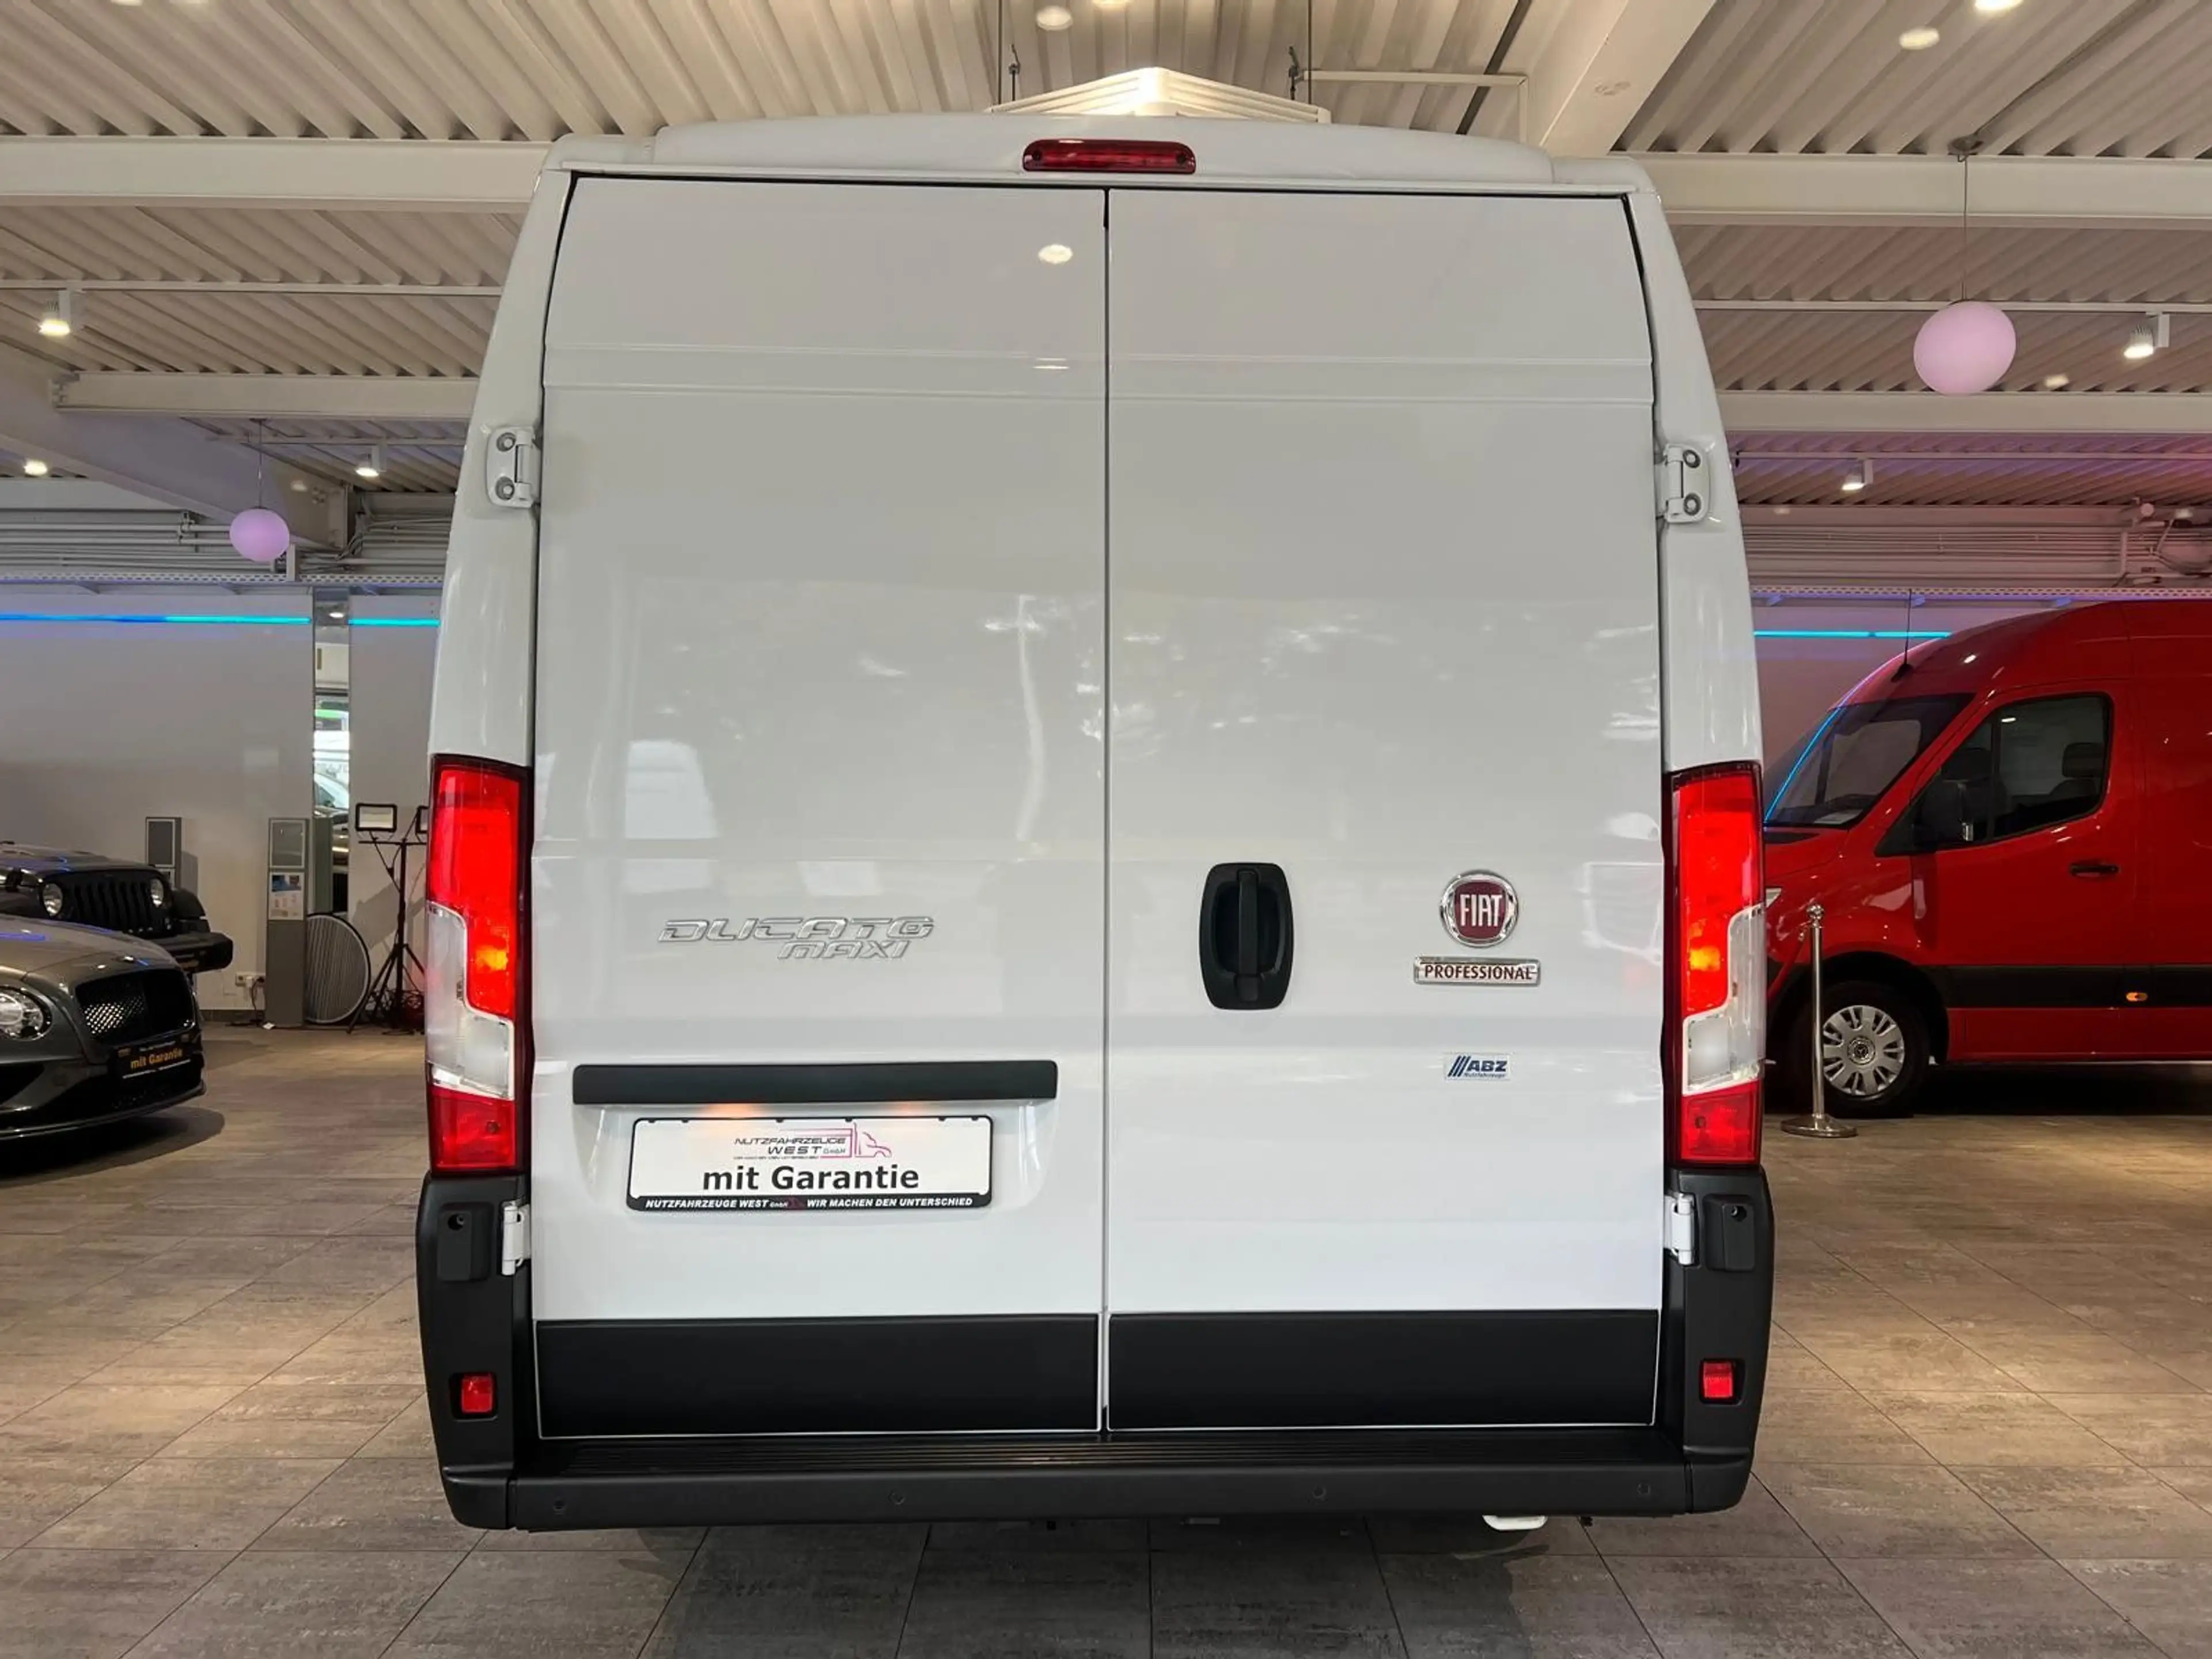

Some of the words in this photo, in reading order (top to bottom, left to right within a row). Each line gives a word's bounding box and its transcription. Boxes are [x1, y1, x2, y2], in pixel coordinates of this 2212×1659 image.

[1460, 894, 1502, 927] FIAT
[658, 916, 934, 942] DUCATO
[777, 940, 911, 959] MAXI
[1425, 964, 1532, 980] PROFESSIONAL
[1466, 1060, 1508, 1071] ABZ
[767, 1146, 823, 1154] WEST
[703, 1165, 759, 1190] mit
[771, 1164, 919, 1190] Garantie
[645, 1199, 737, 1208] NUTZFAHRZEUGE
[738, 1199, 769, 1208] WEST
[807, 1199, 828, 1207] WIR
[829, 1198, 873, 1207] MACHEN
[875, 1198, 898, 1206] DEN
[899, 1197, 973, 1206] UNTERSCHIED
